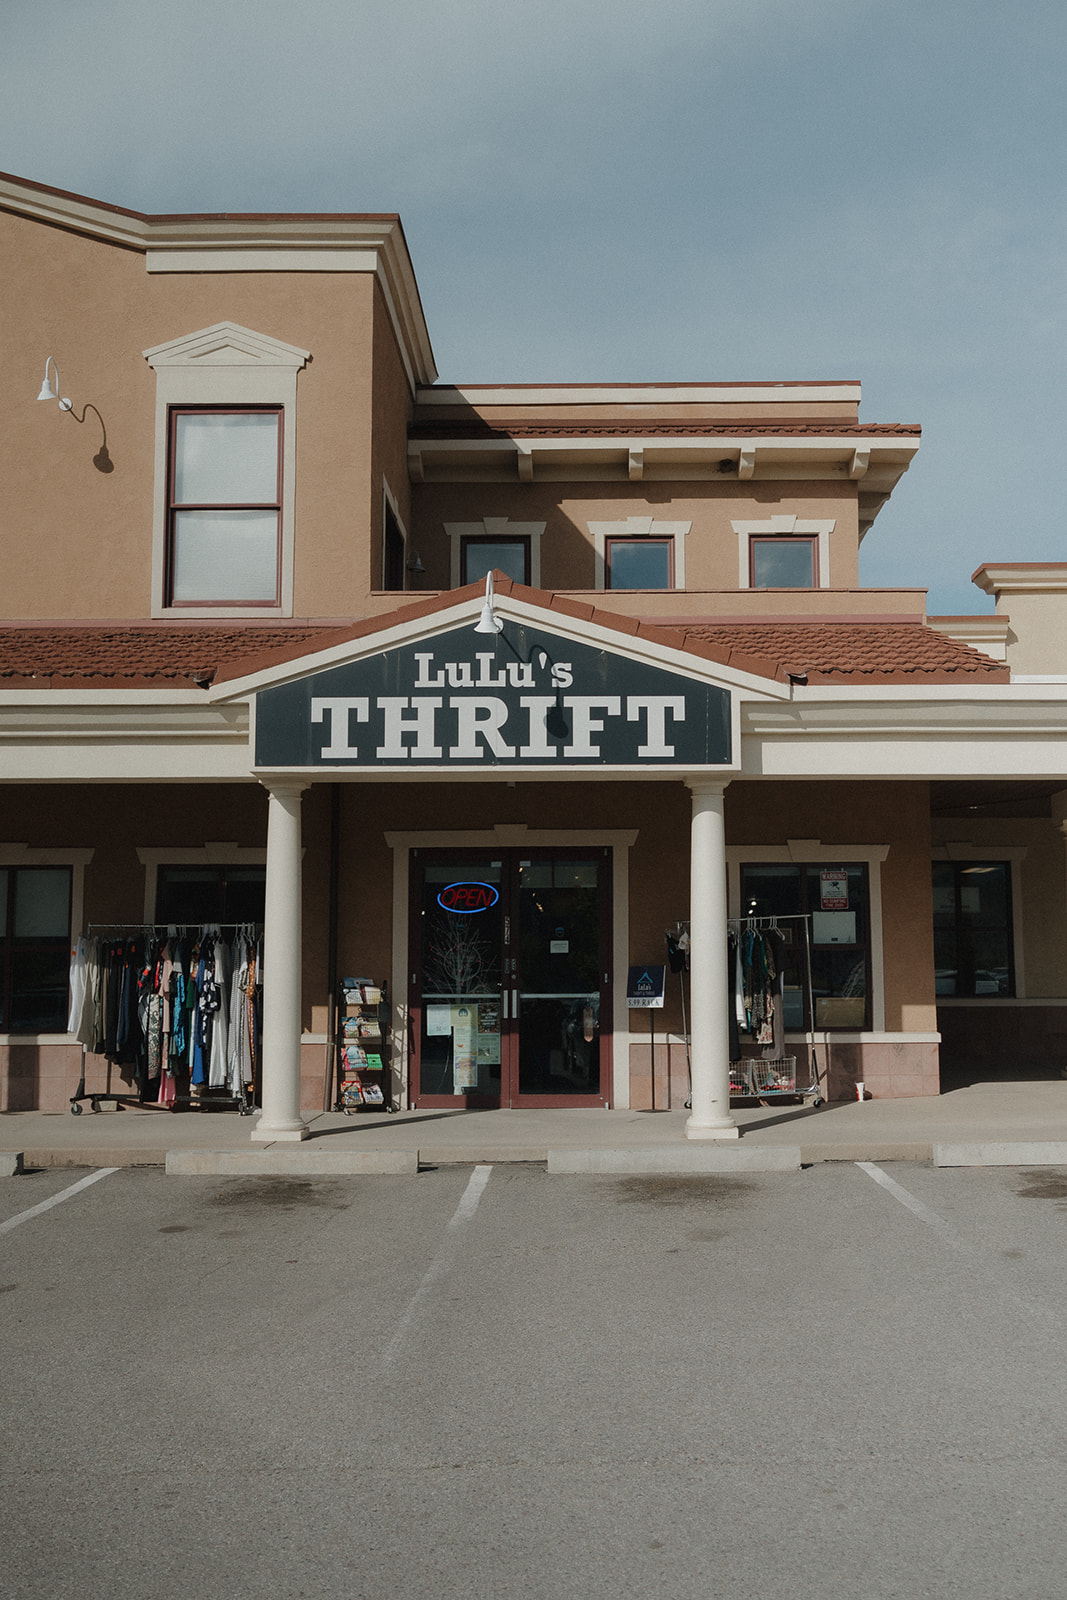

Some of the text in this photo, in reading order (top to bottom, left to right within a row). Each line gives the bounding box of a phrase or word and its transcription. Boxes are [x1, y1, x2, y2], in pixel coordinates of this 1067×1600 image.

[413, 652, 574, 688] LuLu's
[310, 695, 686, 760] THRIFT
[822, 872, 846, 880] WARNING
[441, 888, 494, 907] OPEN
